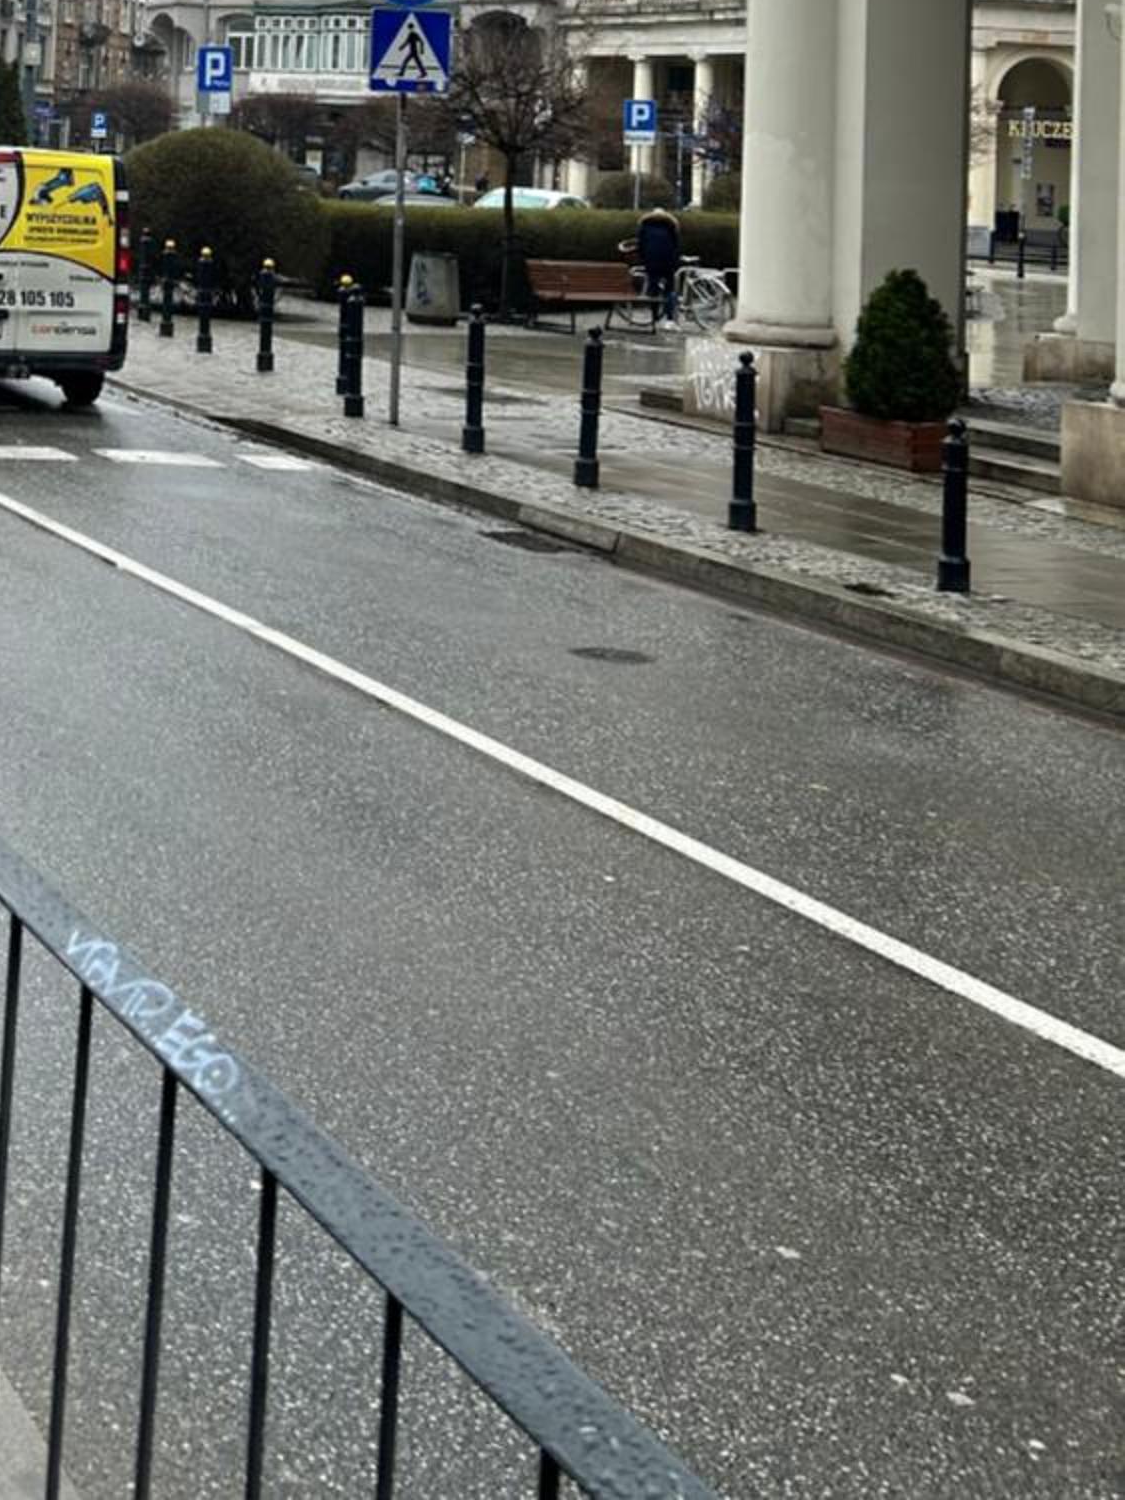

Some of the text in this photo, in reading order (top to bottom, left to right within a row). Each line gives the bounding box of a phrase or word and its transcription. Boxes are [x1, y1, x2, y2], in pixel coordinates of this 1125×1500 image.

[205, 51, 225, 87] P
[631, 103, 651, 128] P
[21, 290, 46, 306] 105
[50, 292, 75, 308] 105
